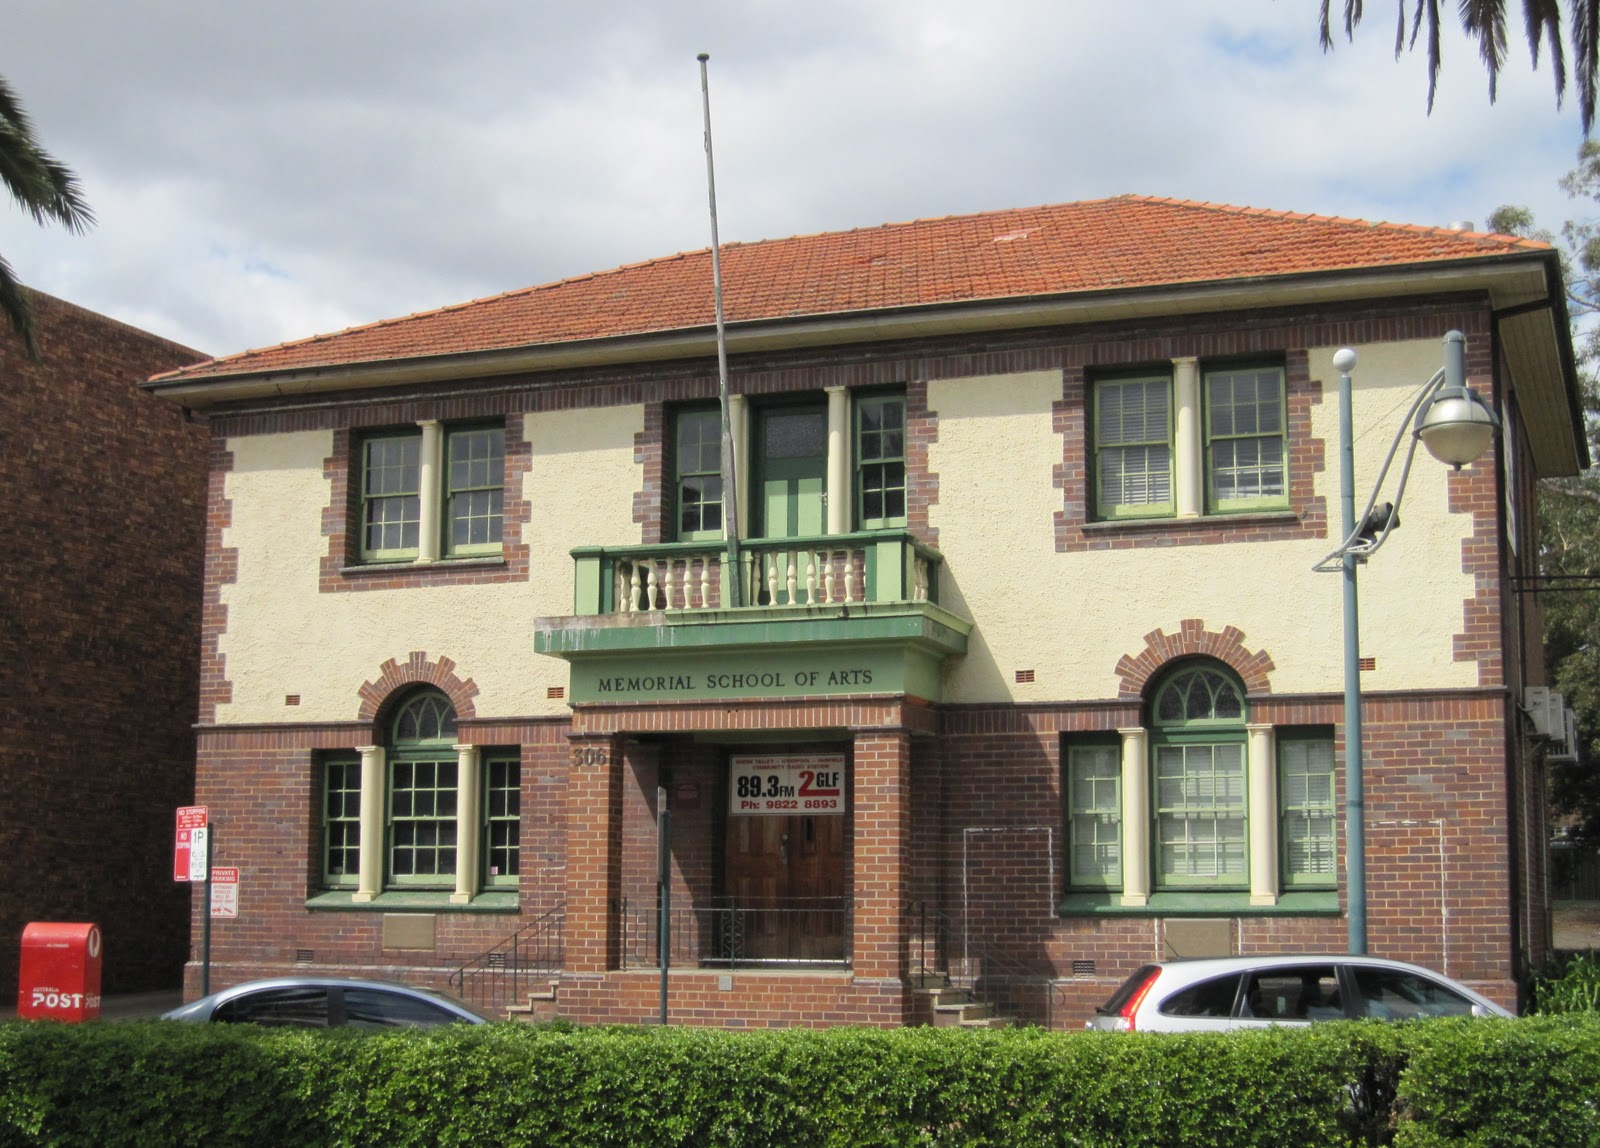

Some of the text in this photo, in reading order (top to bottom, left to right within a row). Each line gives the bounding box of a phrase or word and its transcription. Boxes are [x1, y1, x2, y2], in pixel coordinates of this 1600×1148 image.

[599, 669, 873, 692] MEMORIAL SCHOOL OF ARTS
[571, 748, 607, 767] 306
[741, 799, 837, 809] Ph: 9822 8893
[186, 807, 206, 815] STOPPING
[180, 832, 188, 840] NO
[193, 831, 204, 844] 1P
[32, 992, 84, 1008] POST
